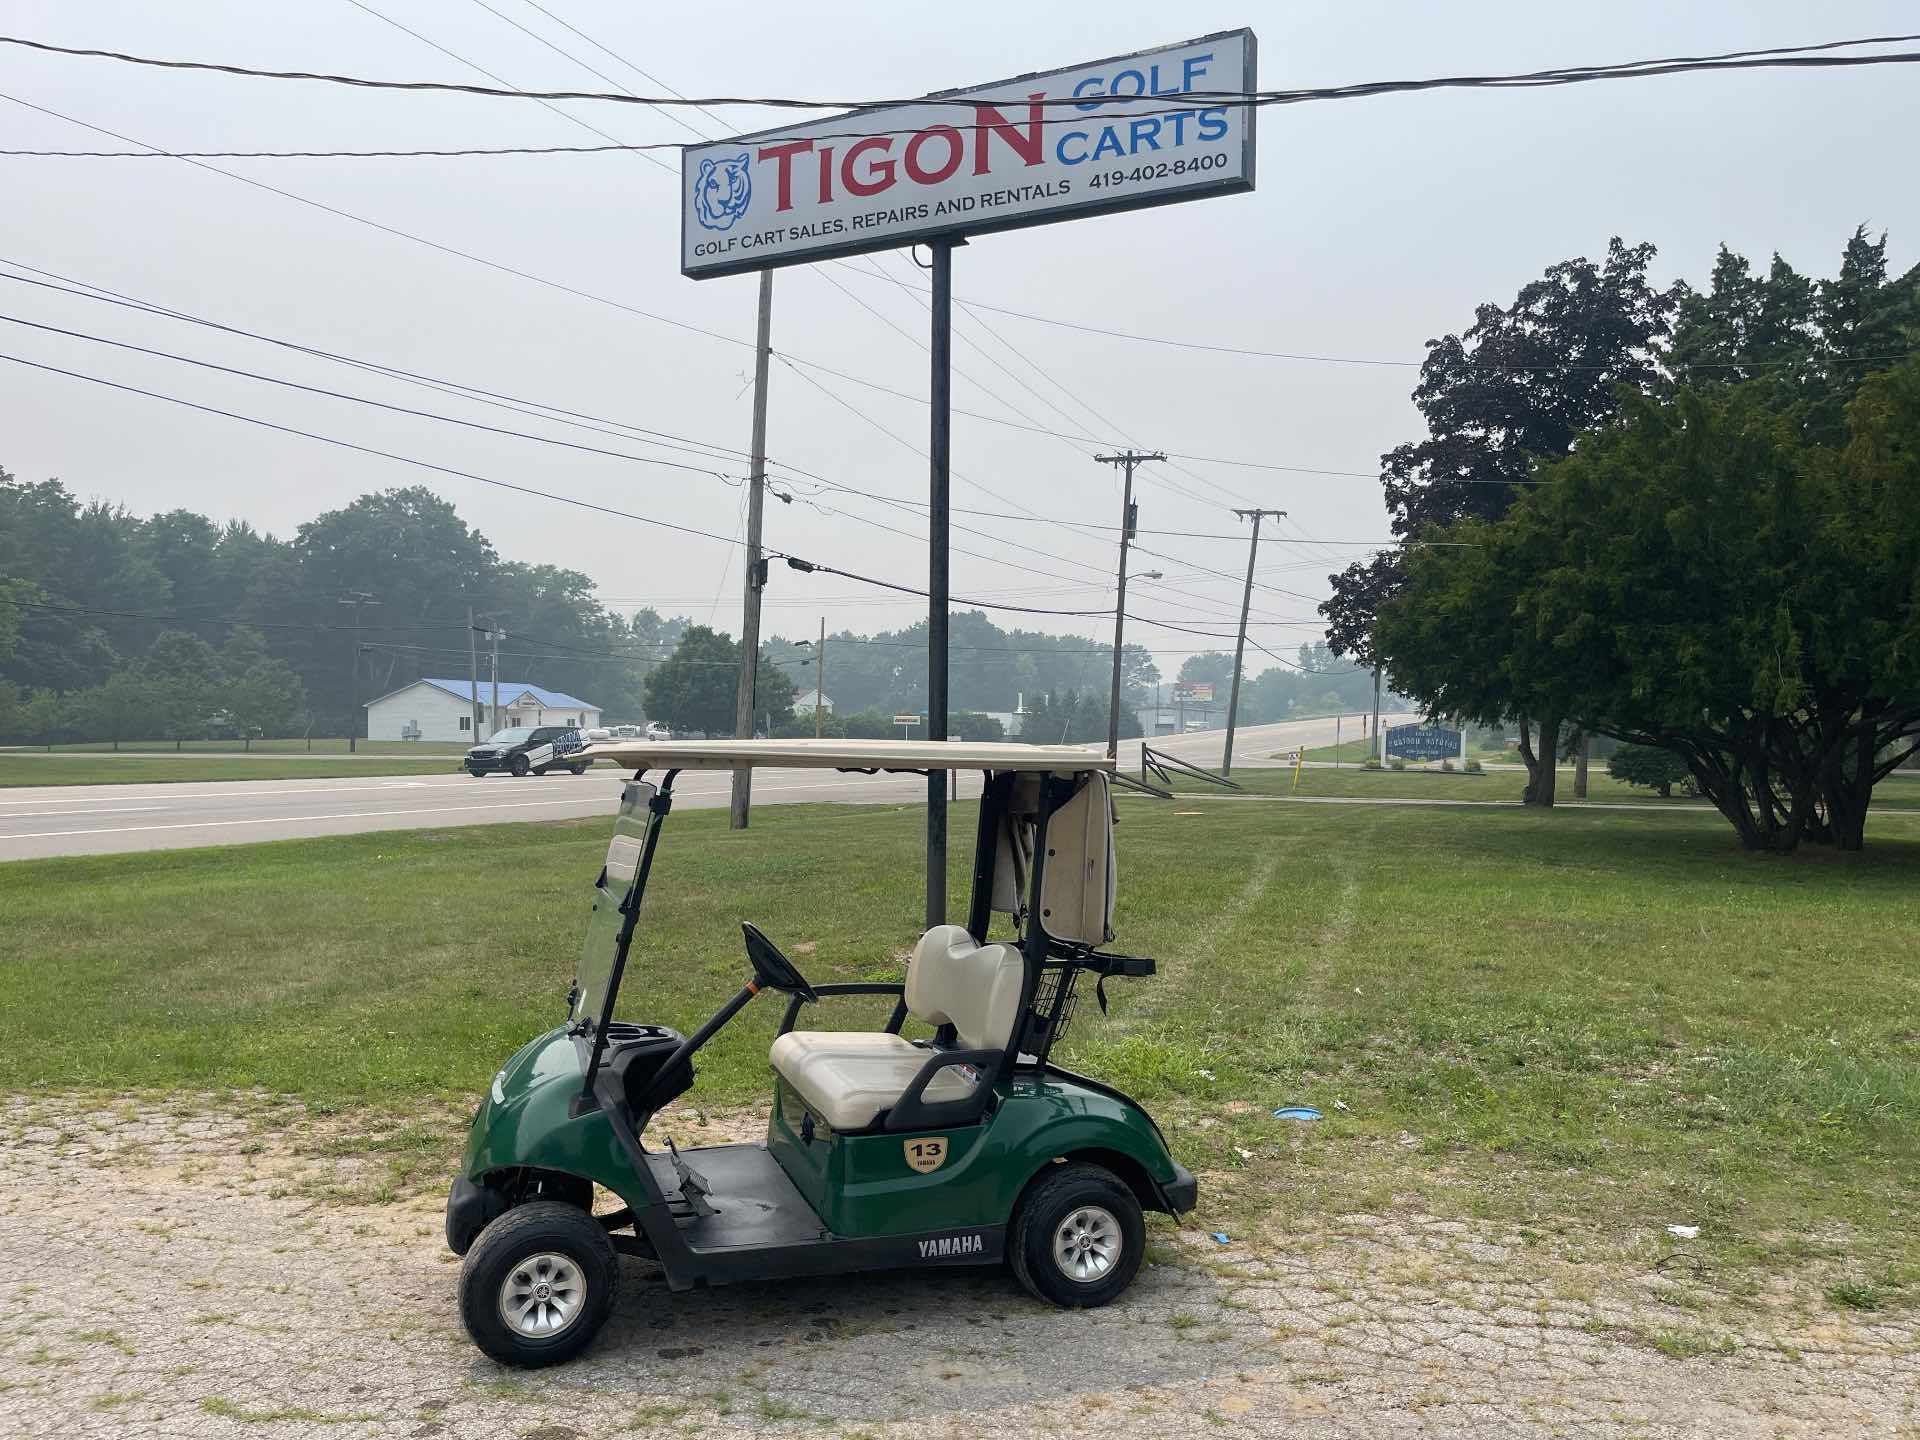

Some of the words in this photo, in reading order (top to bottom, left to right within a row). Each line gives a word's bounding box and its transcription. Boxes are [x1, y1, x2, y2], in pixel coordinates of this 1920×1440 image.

[1072, 53, 1214, 112] GOLF
[757, 92, 1048, 213] TIGON
[1056, 106, 1229, 166] CARTS
[1088, 153, 1228, 190] 419-402-8400
[694, 238, 737, 257] GOLF
[740, 229, 786, 249] CART
[789, 218, 848, 241] SALES,
[852, 204, 929, 230] REPAIRS
[934, 196, 976, 217] AND
[980, 179, 1071, 209] RENTALS
[910, 1143, 942, 1157] 13
[918, 1234, 983, 1258] YAMAHA
